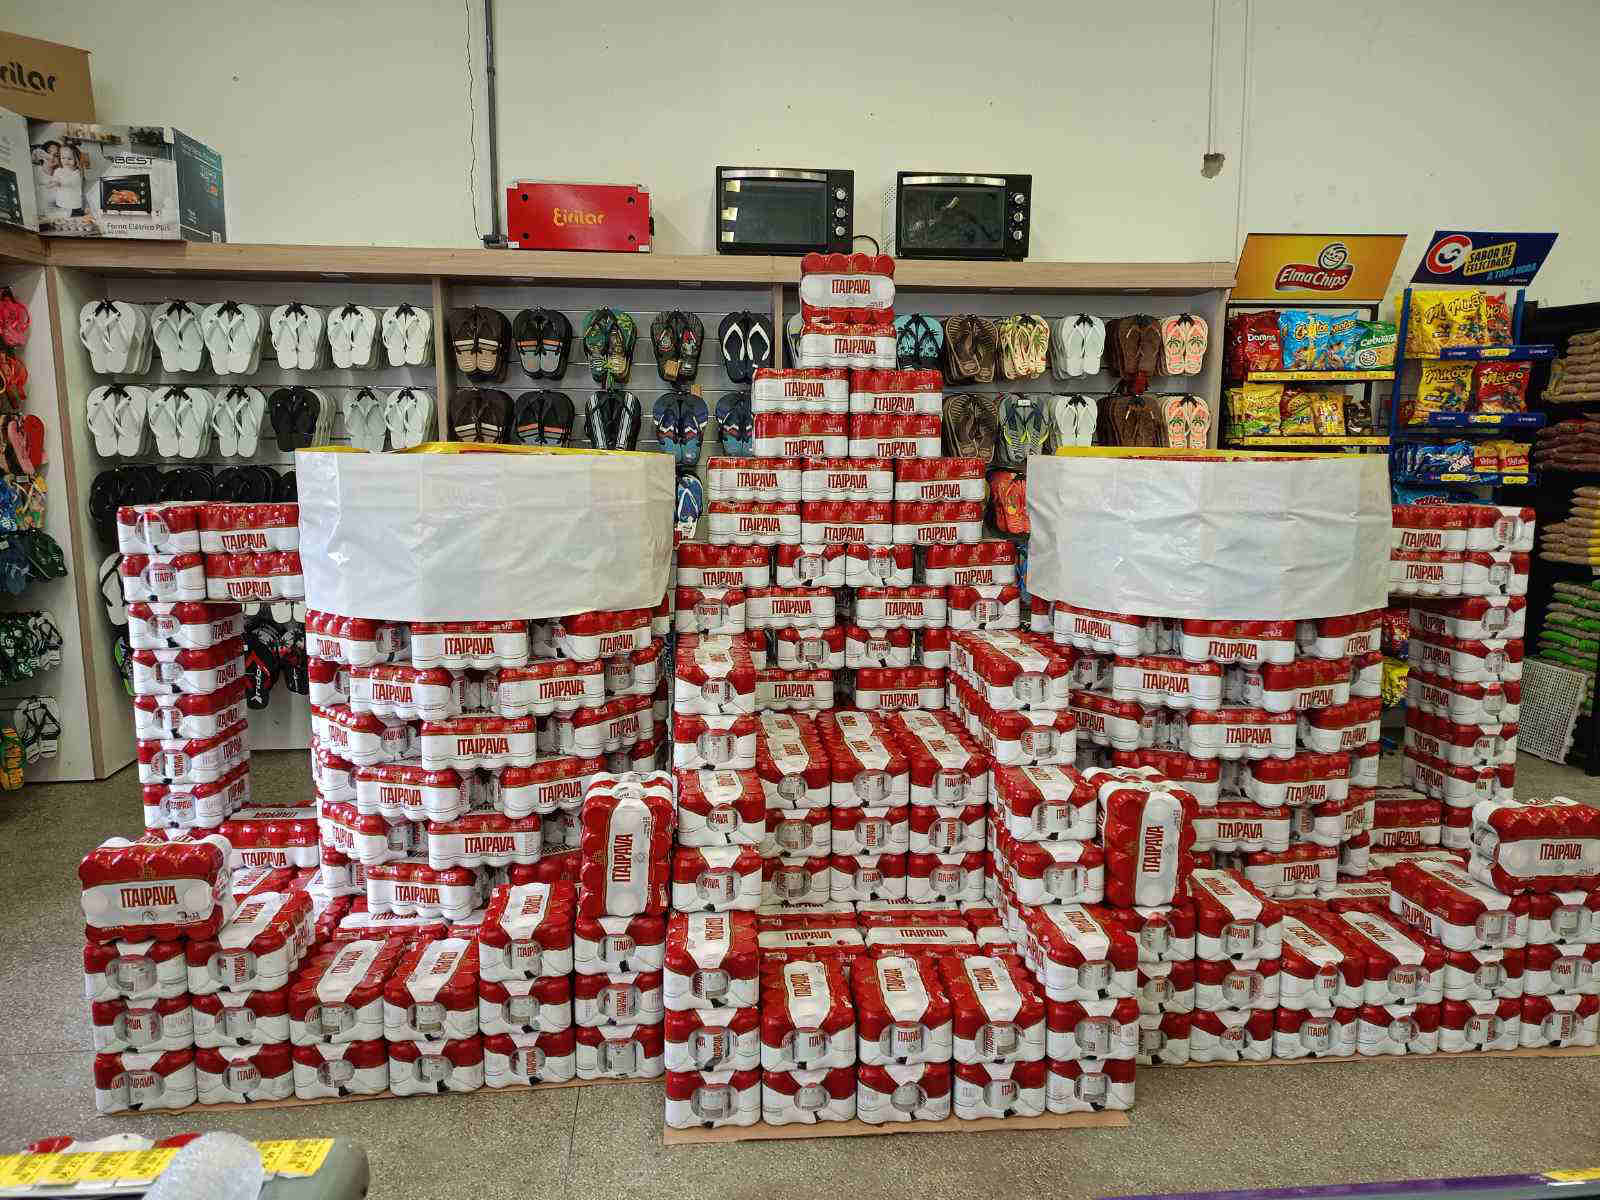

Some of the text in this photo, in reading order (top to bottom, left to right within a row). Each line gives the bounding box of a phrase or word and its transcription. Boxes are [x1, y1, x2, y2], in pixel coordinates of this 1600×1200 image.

[832, 280, 871, 295] ITAIPAVA
[834, 338, 877, 355] ITAIPAVA
[784, 382, 825, 399] ITAIPAVA
[874, 396, 915, 412] ITAIPAVA
[784, 440, 824, 456] ITAIPAVA
[877, 440, 917, 456] ITAIPAVA
[737, 472, 778, 488] ITAIPAVA
[828, 472, 868, 488] ITAIPAVA
[921, 484, 961, 499] ITAIPAVA
[739, 518, 781, 533] ITAIPAVA
[917, 525, 957, 541] ITAIPAVA
[221, 534, 268, 549] ITAIPAVA
[824, 526, 865, 542] ITAIPAVA
[1401, 532, 1441, 548] ITAIPAVA
[703, 571, 743, 586] ITAIPAVA
[955, 569, 993, 585] ITAIPAVA
[1406, 565, 1443, 580] ITAIPAVA
[226, 582, 272, 598] ITAIPAVA
[772, 599, 812, 615] ITAIPAVA
[885, 600, 924, 616] ITAIPAVA
[1074, 617, 1112, 640] ITAIPAVA
[316, 638, 342, 658] ITAIPAVA
[445, 637, 495, 655] ITAIPAVA
[600, 634, 634, 653] ITAIPAVA
[1208, 641, 1257, 660] ITAIPAVA
[540, 679, 585, 699] ITAIPAVA
[1143, 672, 1189, 692] ITAIPAVA
[372, 682, 413, 702] ITAIPAVA
[775, 684, 815, 700] ITAIPAVA
[880, 694, 919, 708] ITAIPAVA
[609, 714, 640, 738] ITAIPAVA
[1073, 710, 1105, 733] TAIPAVA
[1226, 727, 1272, 743] ITAIPAVA
[457, 737, 510, 755] ITAIPAVA
[380, 786, 422, 806] ITAIPAVA
[539, 781, 582, 801] ITAIPAVA
[1285, 785, 1326, 801] ITAIPAVA
[1217, 822, 1263, 838] ITAIPAVA
[464, 837, 516, 854] ITAIPAVA
[1383, 831, 1421, 848] ITAIPAVA
[1142, 824, 1165, 873] ITAIPAVA
[1540, 843, 1582, 861] ITAIPAVA
[241, 851, 287, 867] ITAIPAVA
[612, 833, 634, 883] ITAIPAVA
[1284, 863, 1321, 882] ITAIPAVA
[120, 886, 179, 908] ITAIPAVA
[395, 886, 440, 904] ITAIPAVA
[1401, 900, 1432, 936] ITAIPAVA
[785, 930, 832, 941] ITAIPAVA
[899, 929, 948, 939] ITAIPAVA
